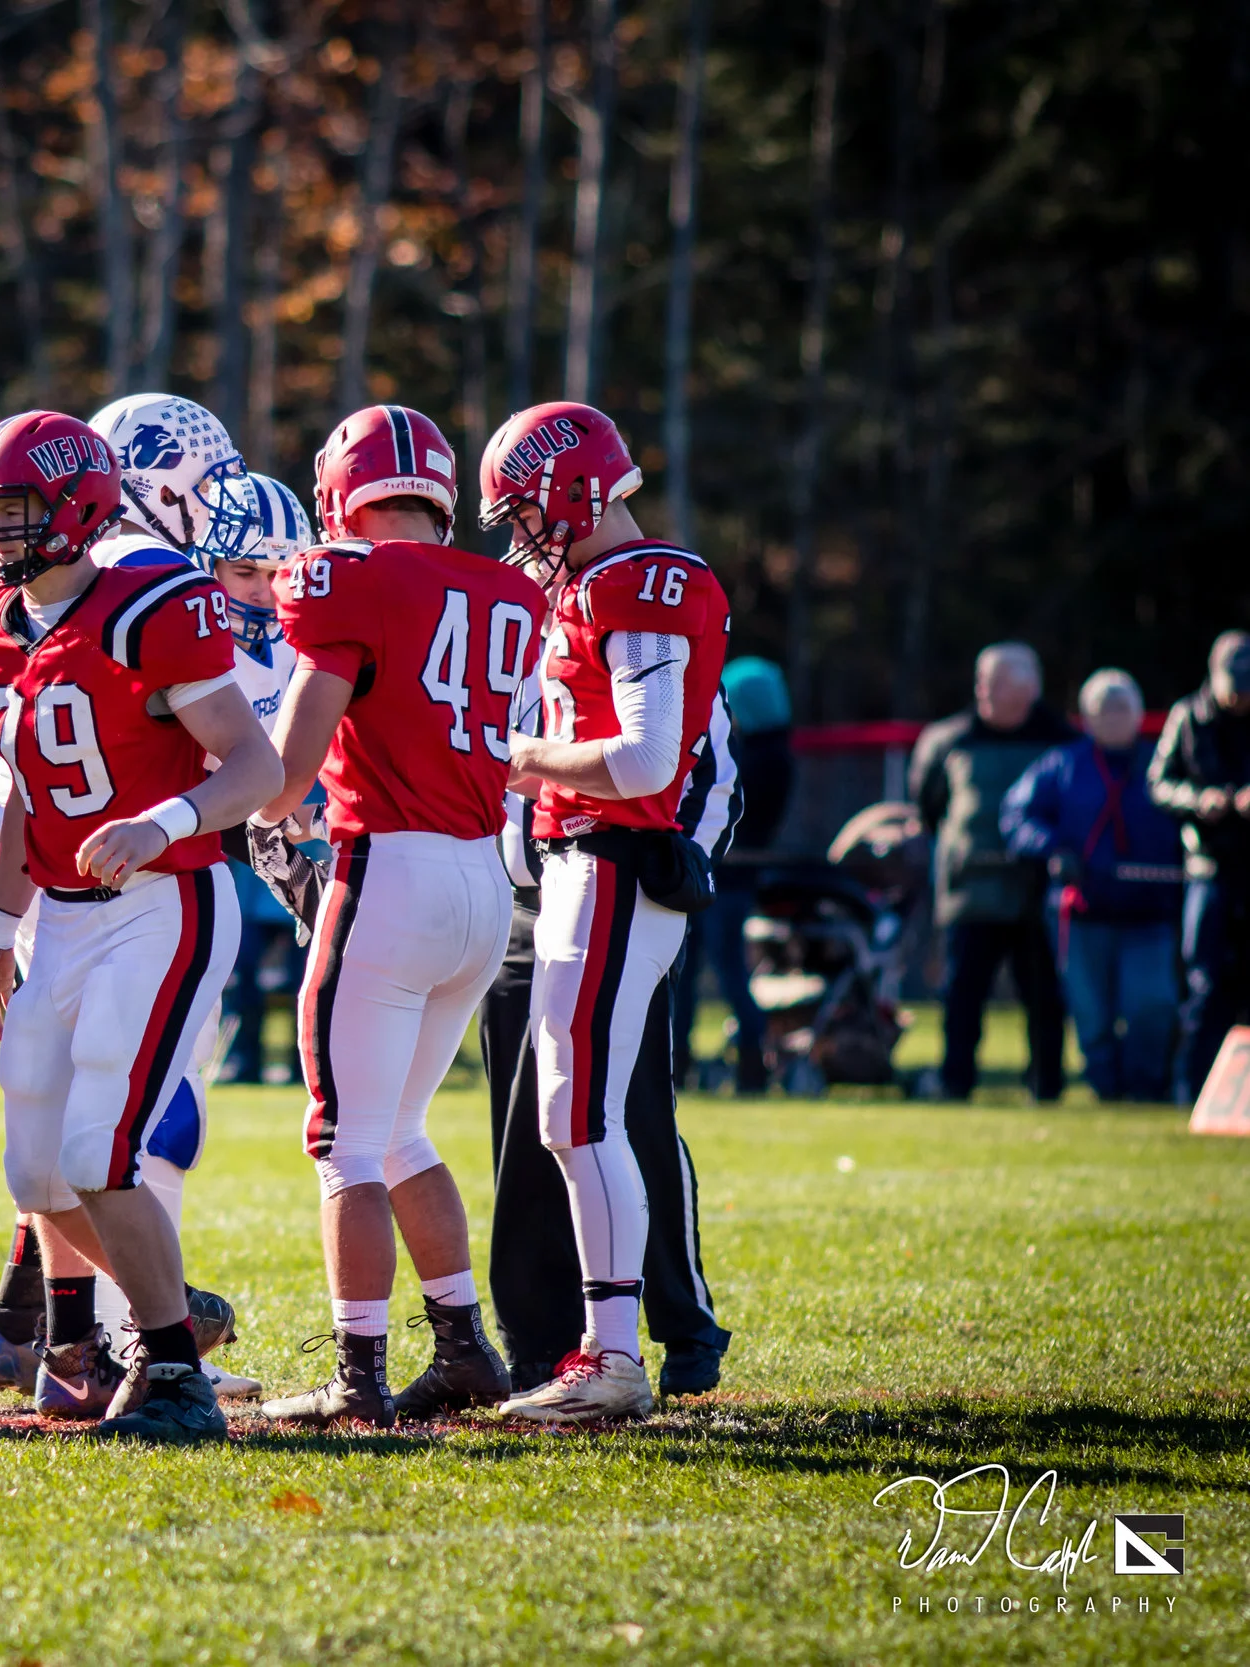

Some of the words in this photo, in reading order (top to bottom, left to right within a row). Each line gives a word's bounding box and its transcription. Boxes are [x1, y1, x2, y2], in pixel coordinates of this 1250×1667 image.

[27, 435, 110, 483] WELLS
[498, 418, 580, 487] WELLS
[288, 558, 332, 600] 49
[637, 563, 689, 607] 16
[184, 590, 231, 639] 79
[418, 588, 533, 763] 49
